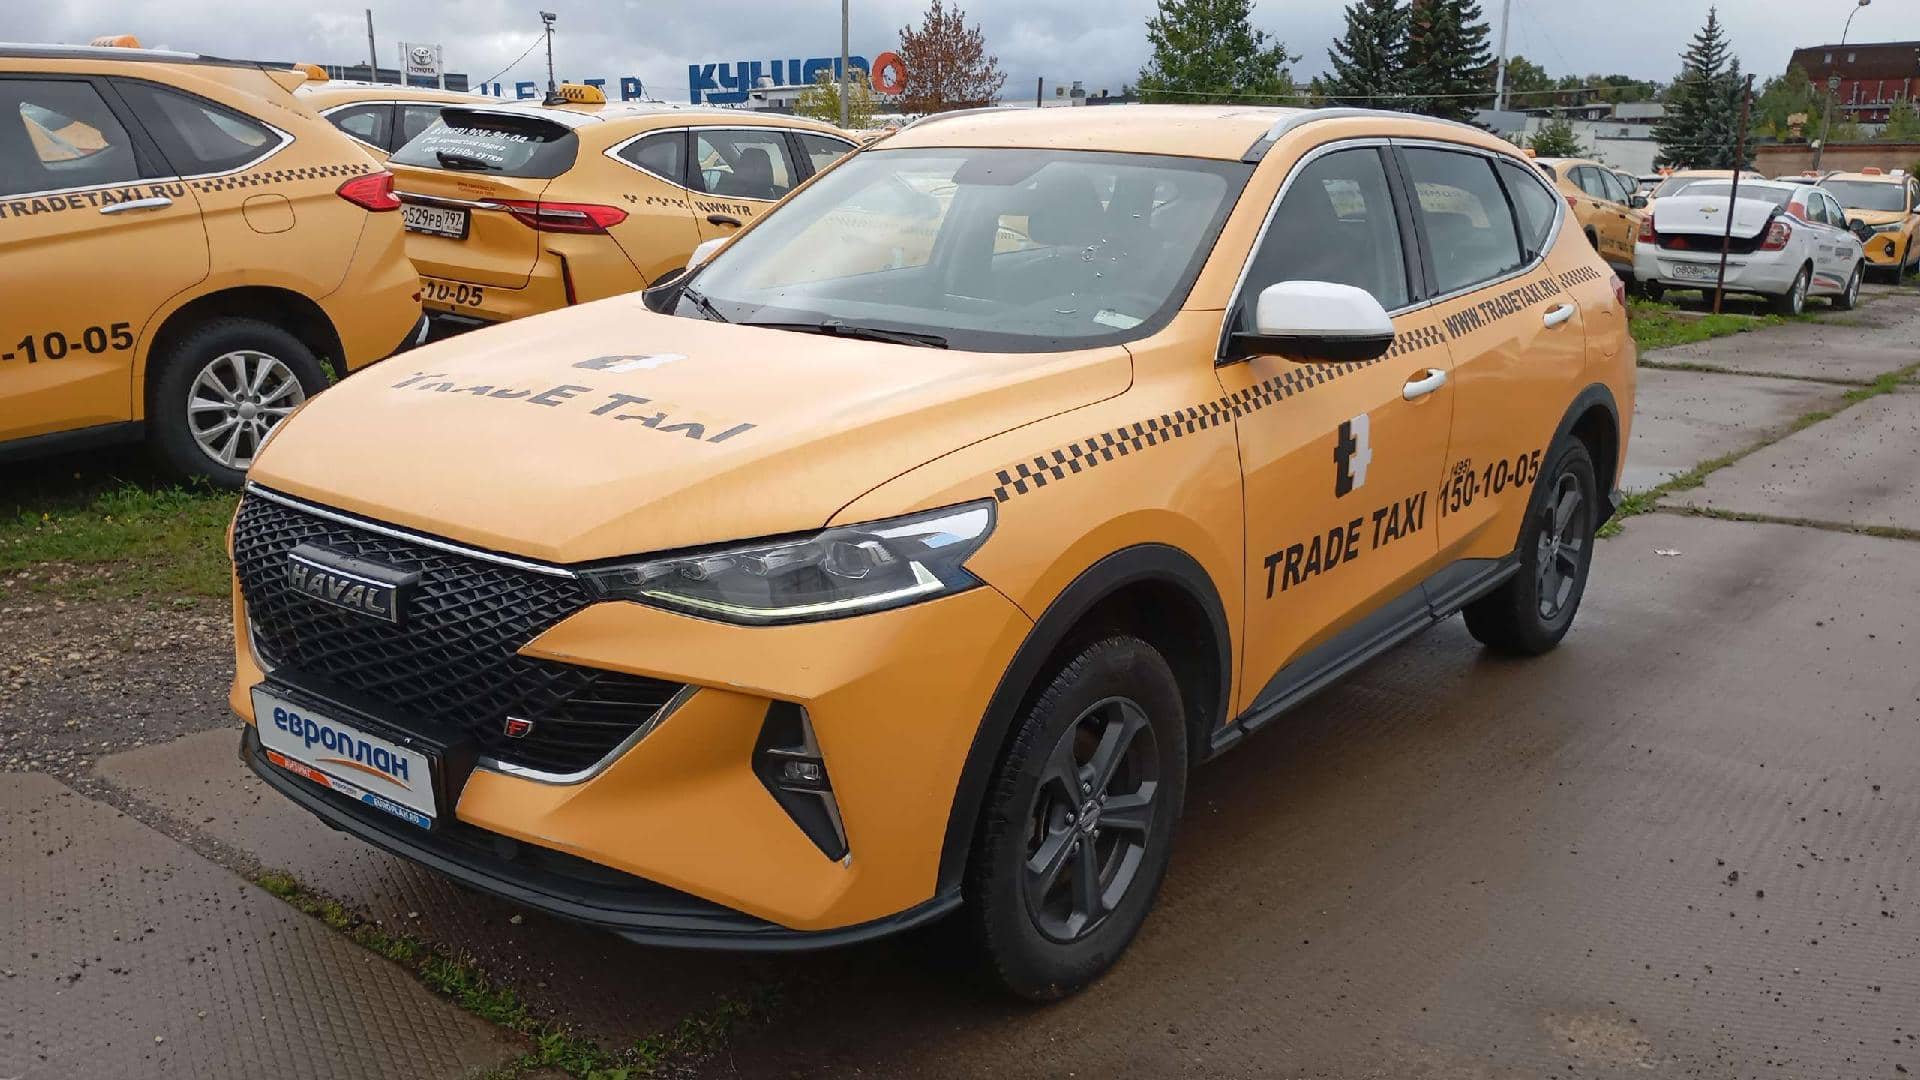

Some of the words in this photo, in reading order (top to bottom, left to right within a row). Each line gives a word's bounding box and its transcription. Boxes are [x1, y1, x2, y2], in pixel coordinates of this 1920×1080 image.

[410, 65, 435, 74] TOYOTA
[445, 211, 461, 226] 797
[1442, 277, 1561, 339] WWW.TRADETAXI.RU
[1440, 449, 1541, 517] 150-10-05
[1264, 517, 1363, 600] TRADE
[1372, 491, 1427, 550] TAXI
[292, 563, 385, 613] HAVAL
[273, 706, 409, 781] европлан
